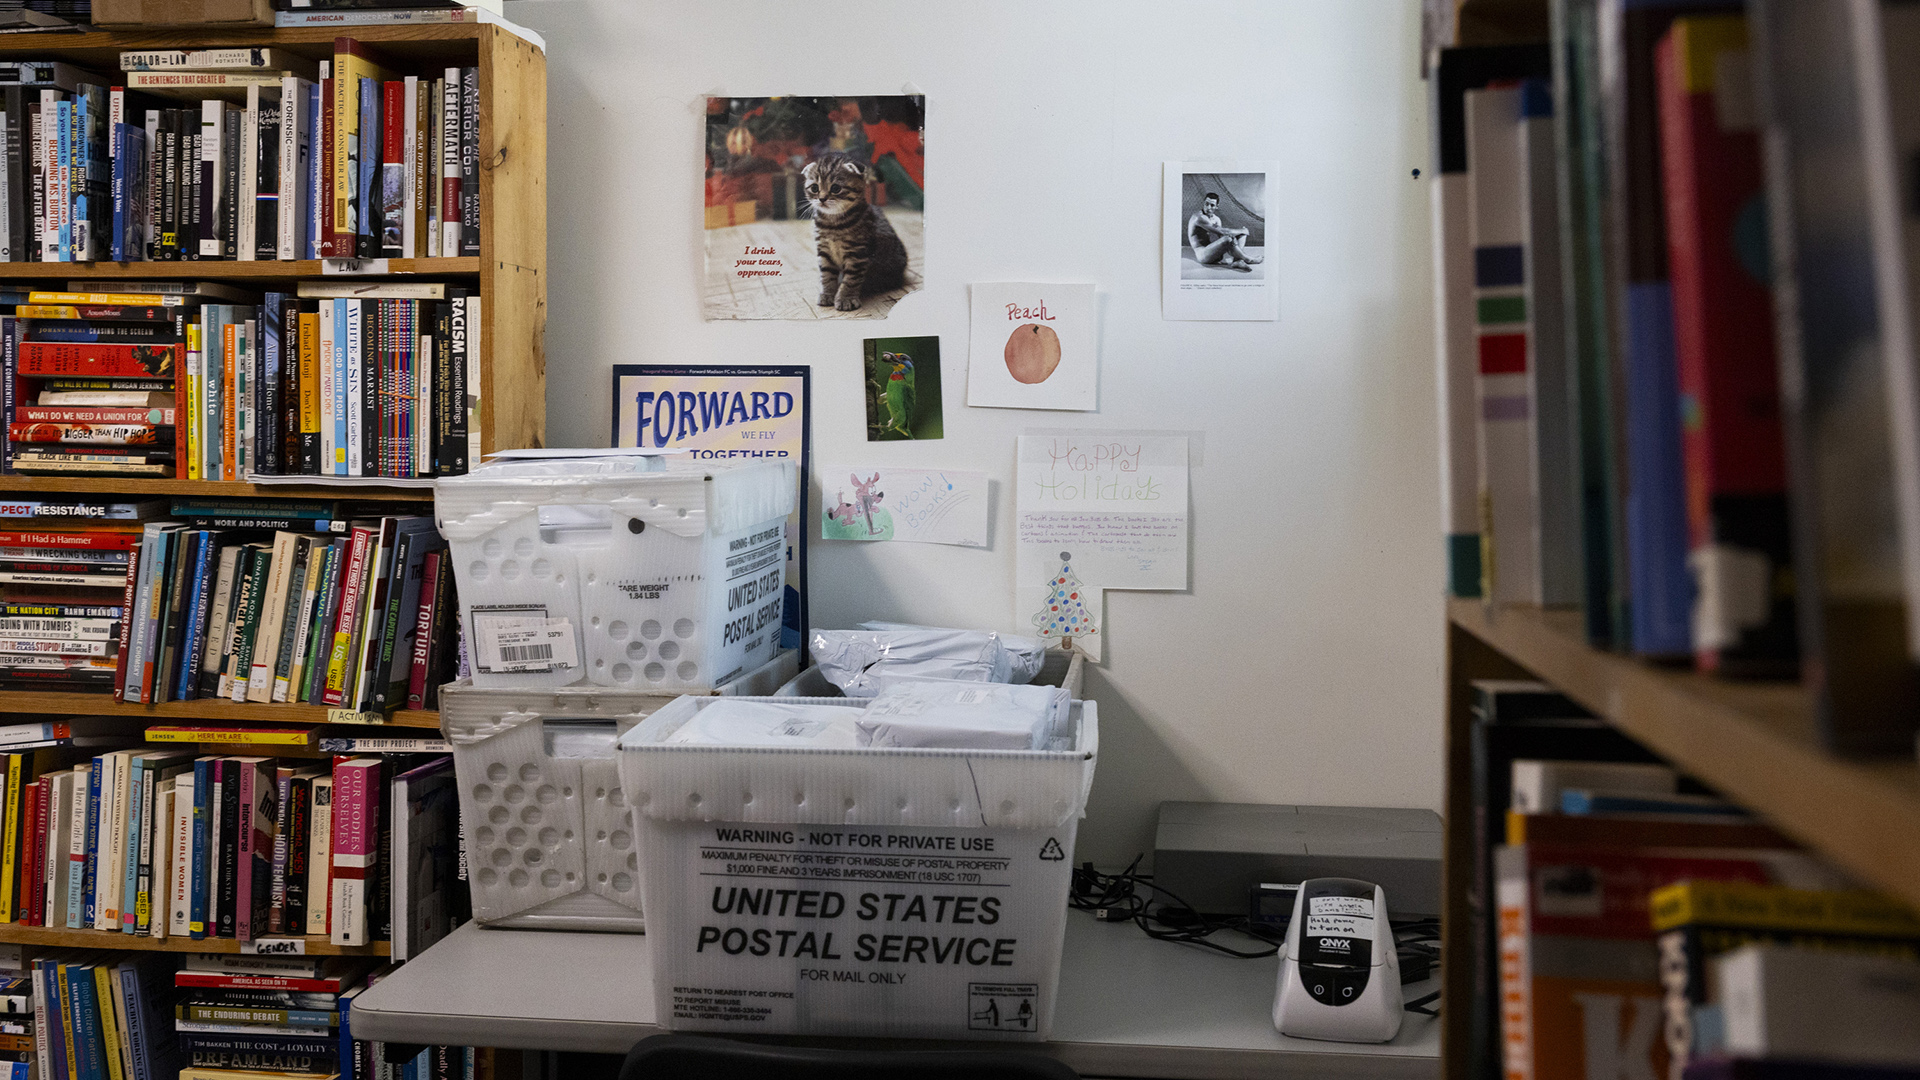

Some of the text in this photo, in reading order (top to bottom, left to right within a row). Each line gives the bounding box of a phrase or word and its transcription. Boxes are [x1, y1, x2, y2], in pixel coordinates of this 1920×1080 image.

[393, 12, 412, 20] NOW
[131, 53, 187, 66] COLOR LAW
[137, 75, 226, 84] THE SENTENCES THAT CREATE US
[445, 83, 459, 165] AFTERMATH
[462, 73, 472, 176] WARRIOR COP
[78, 115, 86, 192] HOMEOWNER'S RIGHTS
[49, 140, 59, 231] BECOMING MS. BURTON
[744, 246, 777, 255] I drink
[339, 261, 359, 272] LAW
[734, 259, 784, 268] your tears,
[736, 270, 783, 279] oppressor.
[1005, 298, 1056, 321] Peach
[348, 307, 358, 393] WHITE as SIN
[5, 334, 13, 407] NEWSROOM CONFIDENTIAL
[366, 313, 375, 411] BECOMING MARXIST
[451, 297, 465, 424] RACISM Essential Readings
[207, 379, 217, 416] white
[27, 411, 149, 421] WHAT DO WE NEED A UNION FOR?
[636, 390, 795, 449] FORWARD
[741, 431, 777, 440] WE FLY
[689, 449, 789, 460] TOGETHER
[0, 505, 105, 516] PECT RESISTANCE
[214, 519, 289, 529] WORK AND POLITICS
[20, 535, 26, 543] If
[32, 535, 49, 543] Had
[57, 536, 92, 545] Hammer
[35, 549, 105, 560] WRECKING CREW
[247, 556, 262, 625] JONATHAN KOZOL
[639, 584, 670, 592] WEIGHT
[645, 591, 660, 599] LBS
[727, 568, 781, 612] UNITED STATES
[6, 606, 59, 615] THE NATION CITY
[64, 608, 119, 617] RAHM EMANUEL
[723, 612, 755, 648] POSTAL
[756, 597, 781, 631] SERVICE
[413, 603, 431, 666] TORTURE
[359, 740, 417, 748] THE BODY PROJECT
[277, 801, 286, 828] KENDALL
[340, 775, 350, 845] OURSELVES
[350, 769, 361, 852] OUR BODIES,
[241, 803, 250, 852] Intercourse
[179, 816, 187, 863] INVISIBLE
[273, 833, 286, 861] HOOD
[716, 829, 795, 848] WARNING
[809, 832, 843, 846] NOT
[849, 833, 882, 848] FOR
[888, 835, 956, 850] PRIVATE
[961, 838, 994, 851] USE
[702, 850, 1009, 870] MAXIMUM PENALTY FOR THEFT OR MISUSE OF POSTAL PROPERTY
[726, 863, 755, 874] $1,000
[757, 865, 778, 874] FINE
[779, 866, 800, 875] AND
[809, 867, 841, 877] YEARS
[843, 868, 917, 880] IMPRISONMENT
[919, 872, 932, 881] (18
[934, 872, 955, 882] USC
[957, 874, 982, 884] 1707)
[271, 863, 285, 908] FEMINISM
[711, 886, 1002, 926] UNITED STATES
[1319, 924, 1341, 932] turn
[1333, 917, 1355, 925] power
[257, 942, 297, 954] GENDER
[696, 926, 1017, 967] POSTAL SERVICE
[1319, 938, 1351, 949] ONYX
[800, 968, 907, 984] FOR MAIL ONLY
[673, 986, 702, 994] RETURN
[714, 988, 747, 997] NEAREST
[749, 990, 768, 998] POST
[769, 991, 795, 999] OFFICE
[81, 981, 98, 1070] Global Citizen Patriots
[198, 1010, 280, 1021] THE ENDURING DEBATE
[127, 991, 143, 1066] TEACHING WORKING
[192, 1051, 312, 1068] DREAMLAND
